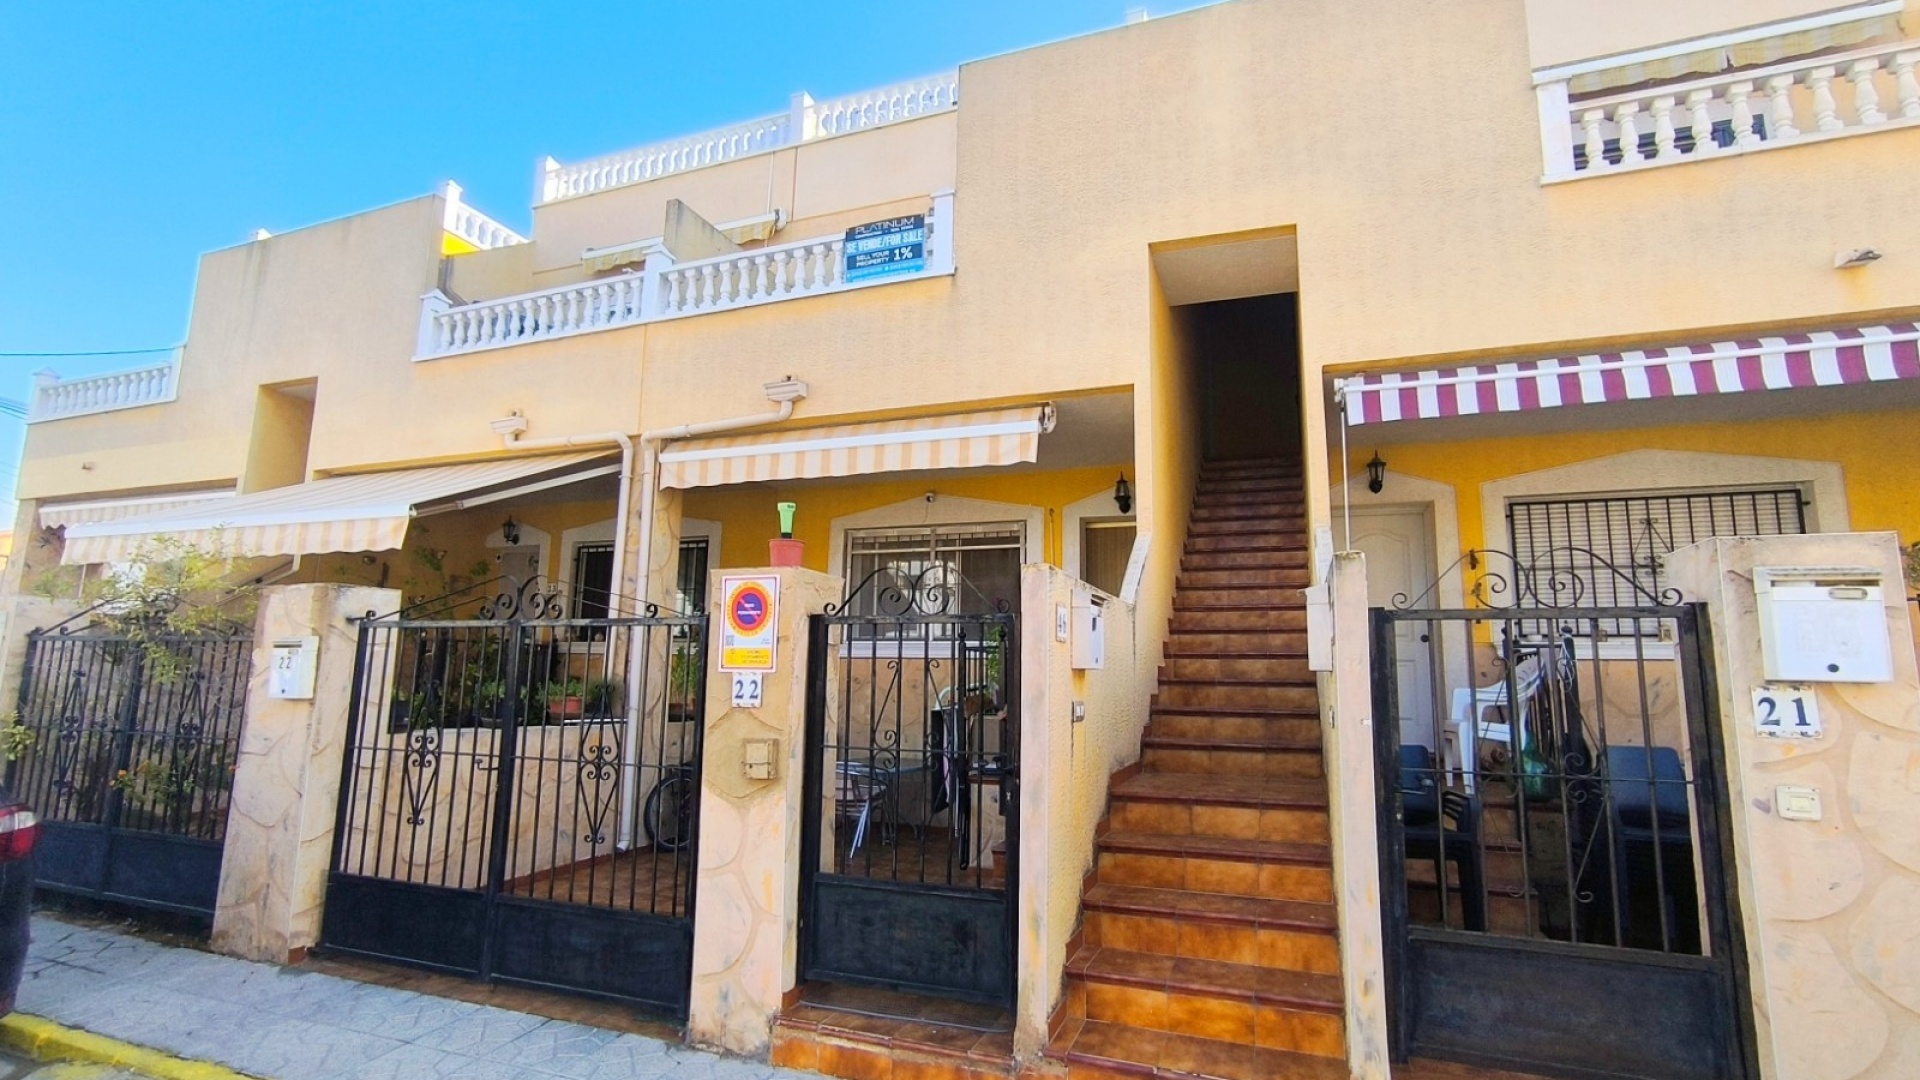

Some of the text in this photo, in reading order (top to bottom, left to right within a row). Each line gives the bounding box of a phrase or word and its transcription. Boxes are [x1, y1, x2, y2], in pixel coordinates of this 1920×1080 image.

[855, 216, 915, 235] PLATINUM
[846, 241, 858, 254] SE
[903, 229, 923, 242] SALE
[871, 250, 890, 259] YOUR
[893, 246, 913, 261] 1%
[856, 257, 890, 268] PROPERTY
[279, 656, 291, 669] 22
[734, 679, 759, 700] 22
[1757, 696, 1812, 727] 21
